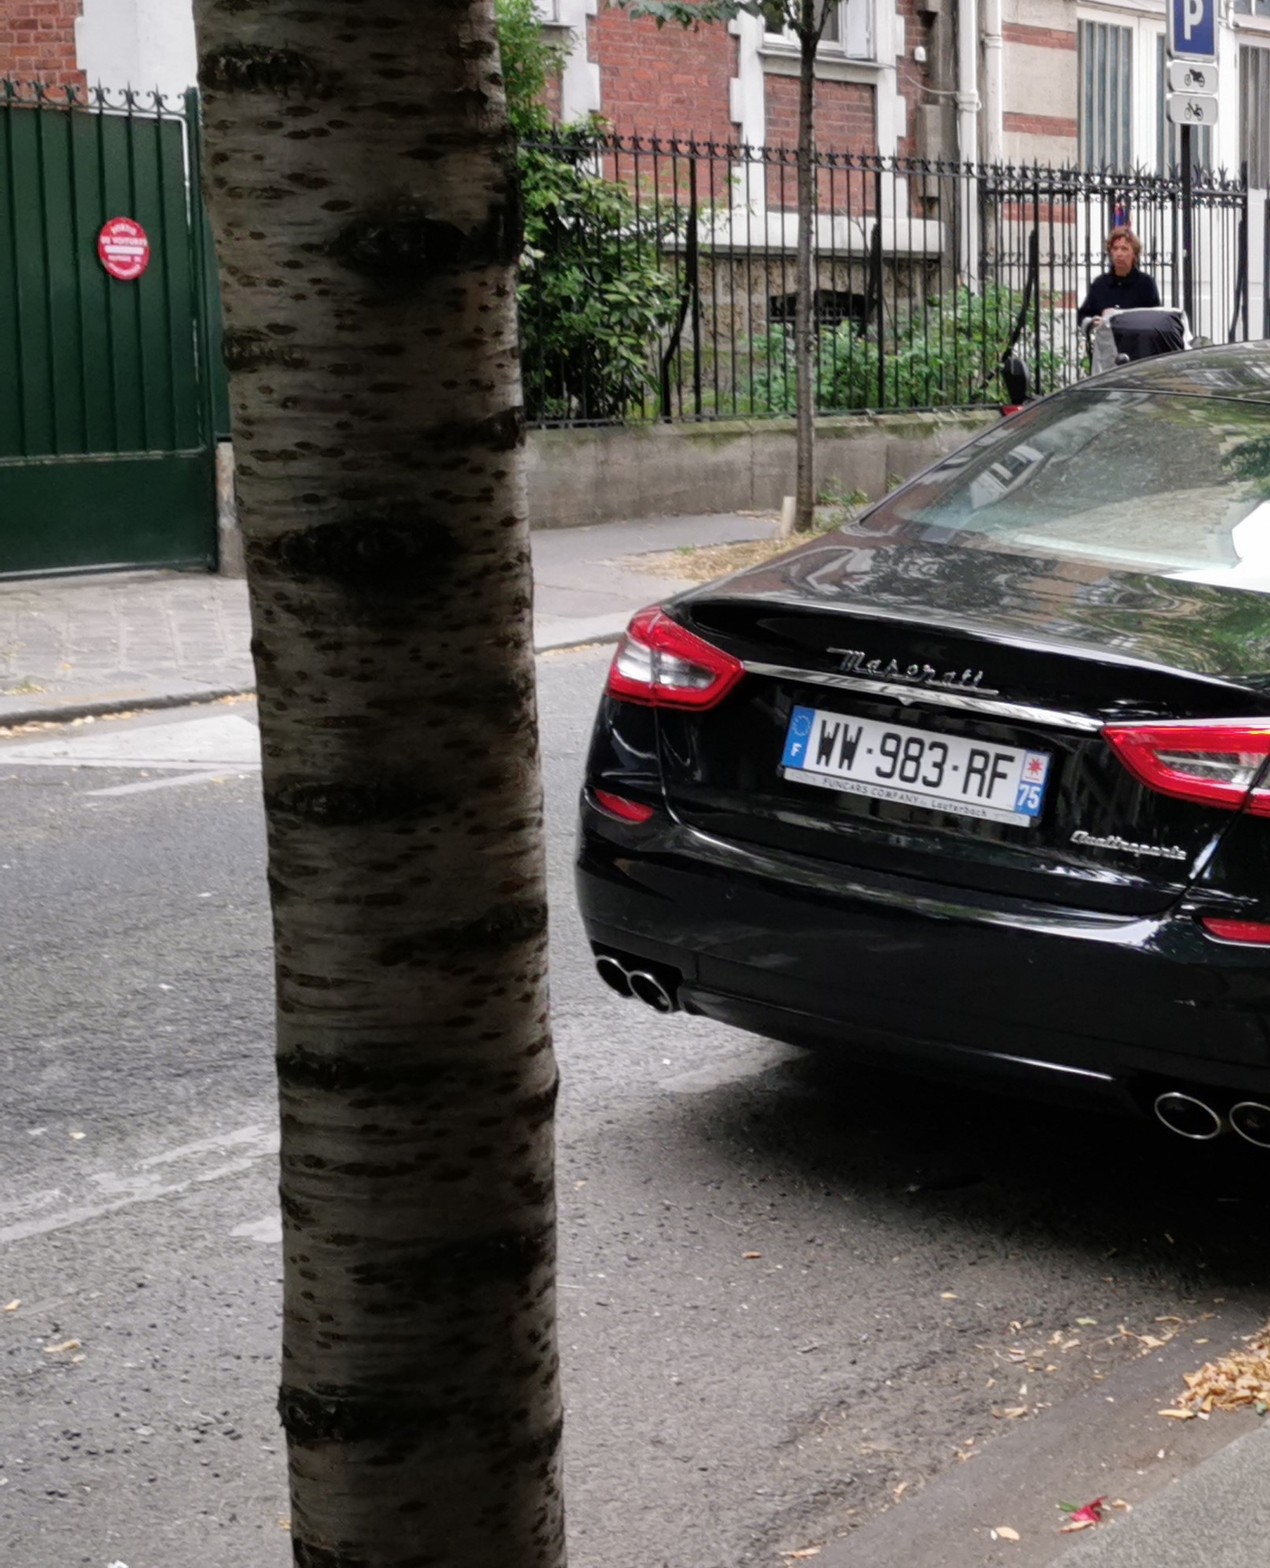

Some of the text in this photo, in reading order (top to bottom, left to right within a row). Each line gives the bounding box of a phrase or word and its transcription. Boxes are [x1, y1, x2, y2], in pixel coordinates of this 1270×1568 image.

[1184, 0, 1204, 41] P
[826, 646, 1000, 696] Maserati
[789, 742, 802, 758] F
[815, 718, 1016, 800] WW-983-RF
[822, 777, 868, 795] FUNCARS
[870, 787, 921, 805] COMPANY
[1017, 783, 1041, 810] 75
